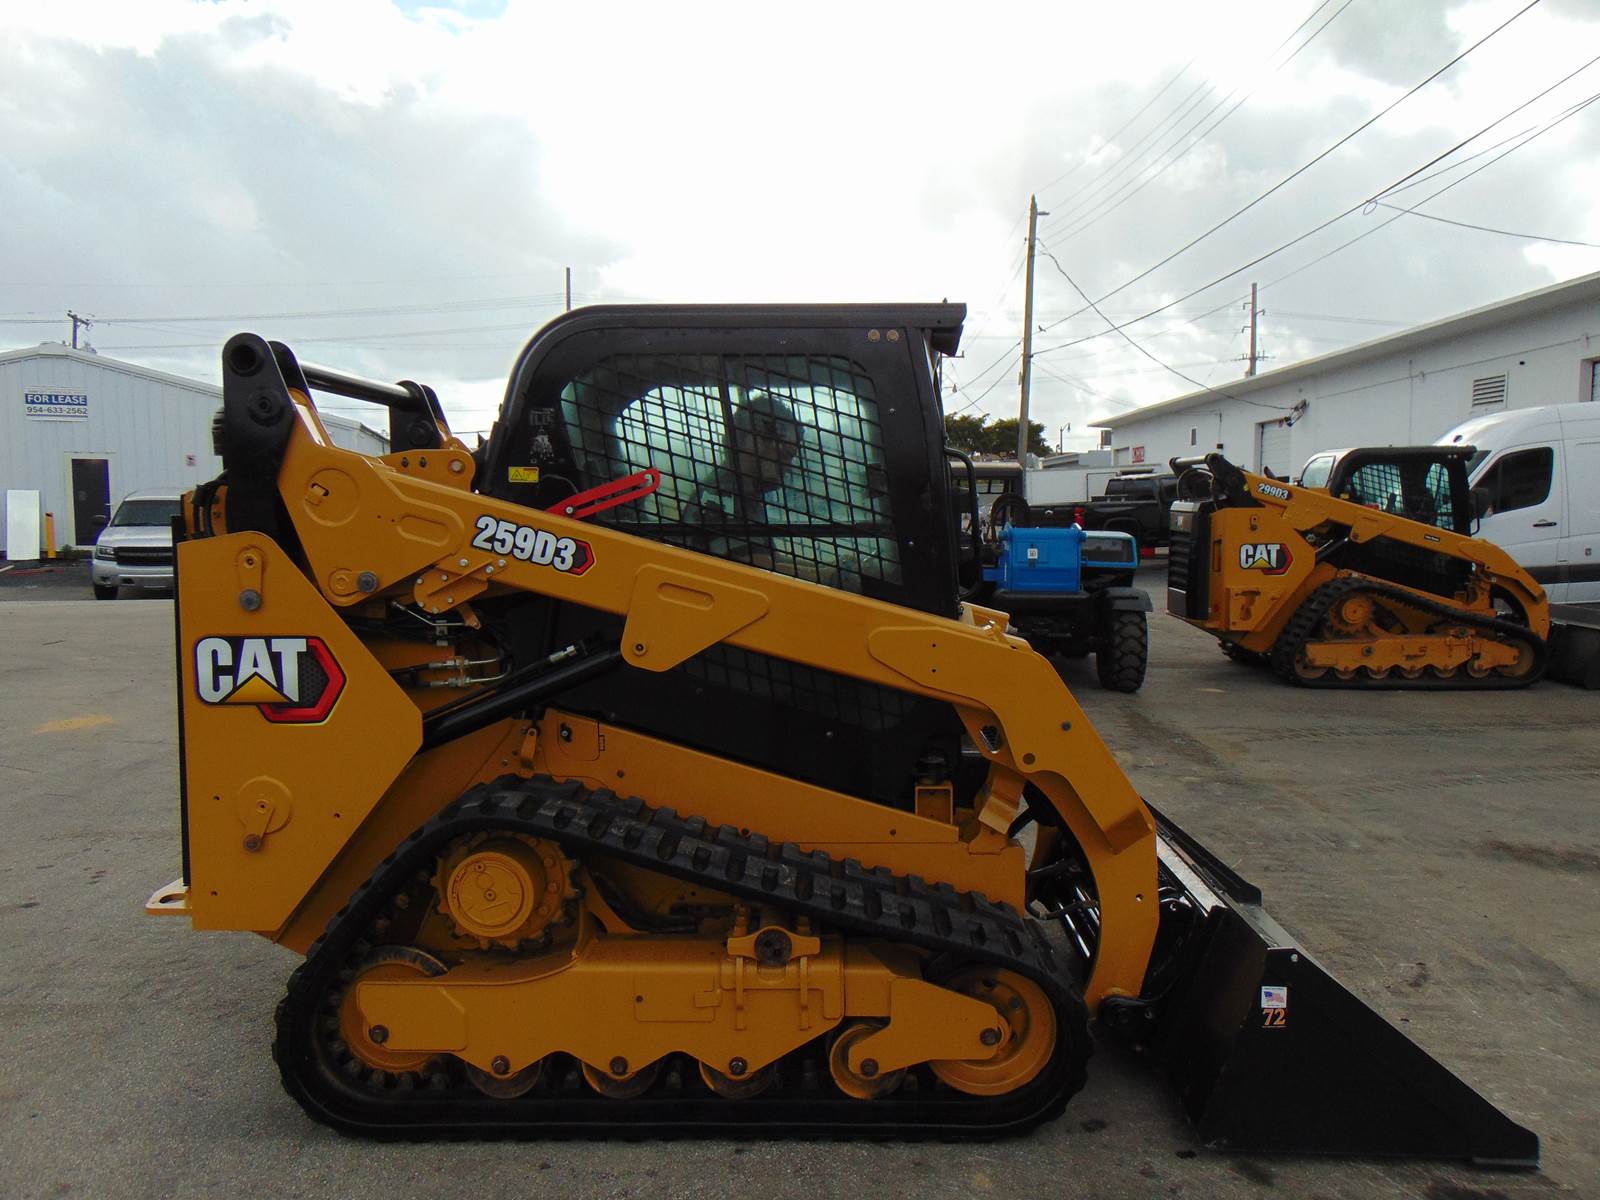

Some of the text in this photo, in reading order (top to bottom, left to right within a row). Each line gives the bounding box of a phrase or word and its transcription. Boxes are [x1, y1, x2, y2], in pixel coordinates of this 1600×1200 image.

[26, 406, 88, 415] 954-633-2562
[27, 394, 86, 405] FOR LEASE
[472, 515, 577, 572] 259D3
[1239, 543, 1281, 569] CAT
[196, 636, 308, 704] CAT
[1262, 1008, 1287, 1026] 72
